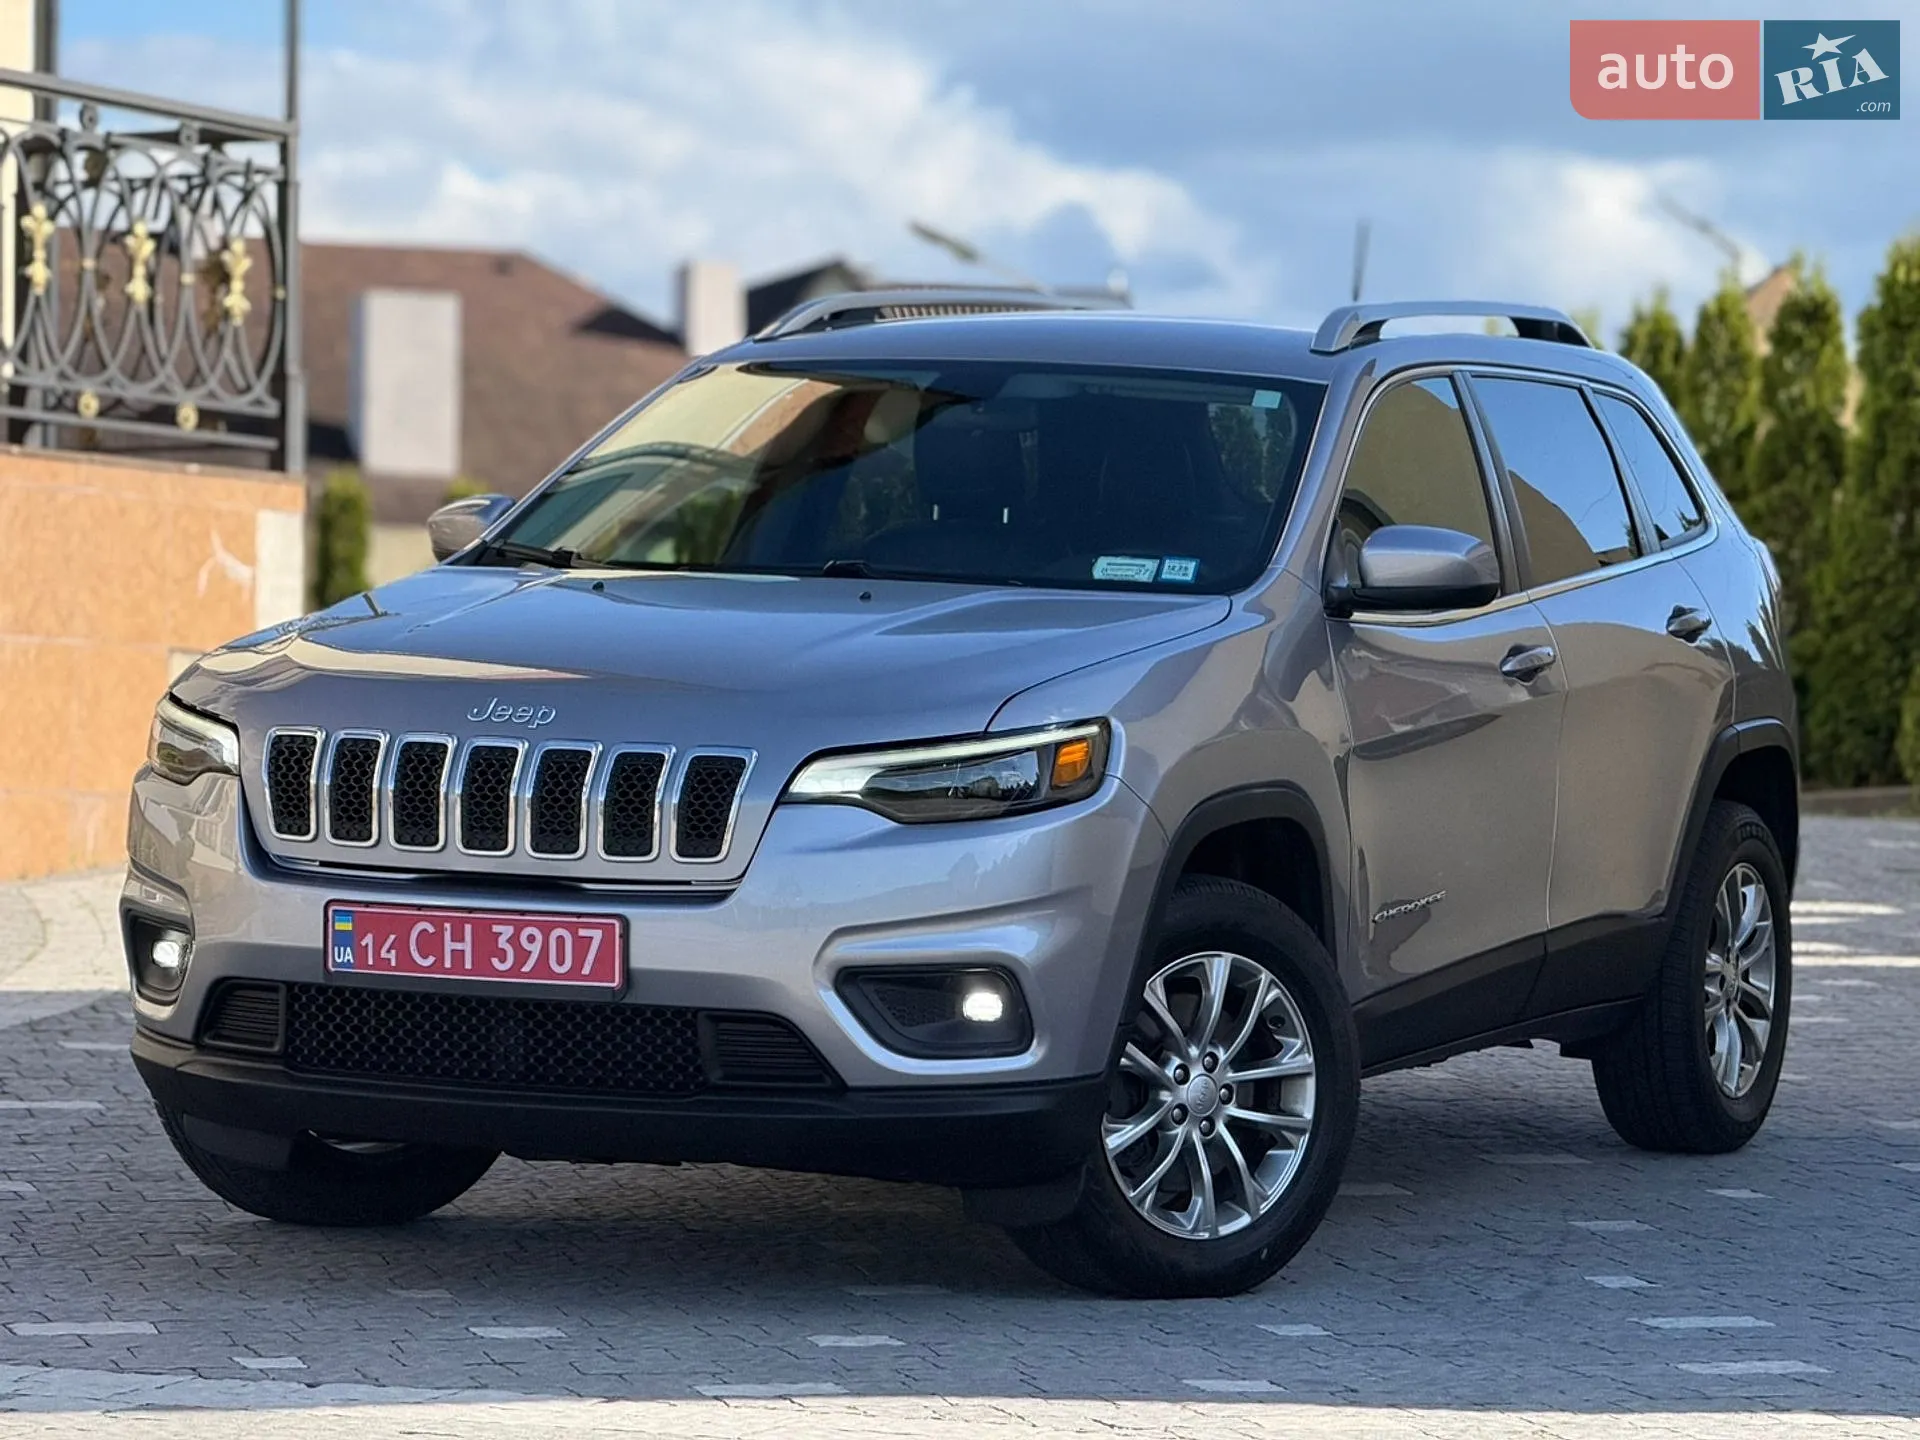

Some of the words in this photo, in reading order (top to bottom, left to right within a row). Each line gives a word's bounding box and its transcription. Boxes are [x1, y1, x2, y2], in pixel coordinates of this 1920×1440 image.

[466, 697, 556, 729] Jeep
[334, 946, 354, 964] UA
[360, 933, 397, 967] 14
[409, 921, 473, 970] CH
[490, 924, 603, 976] 3907
